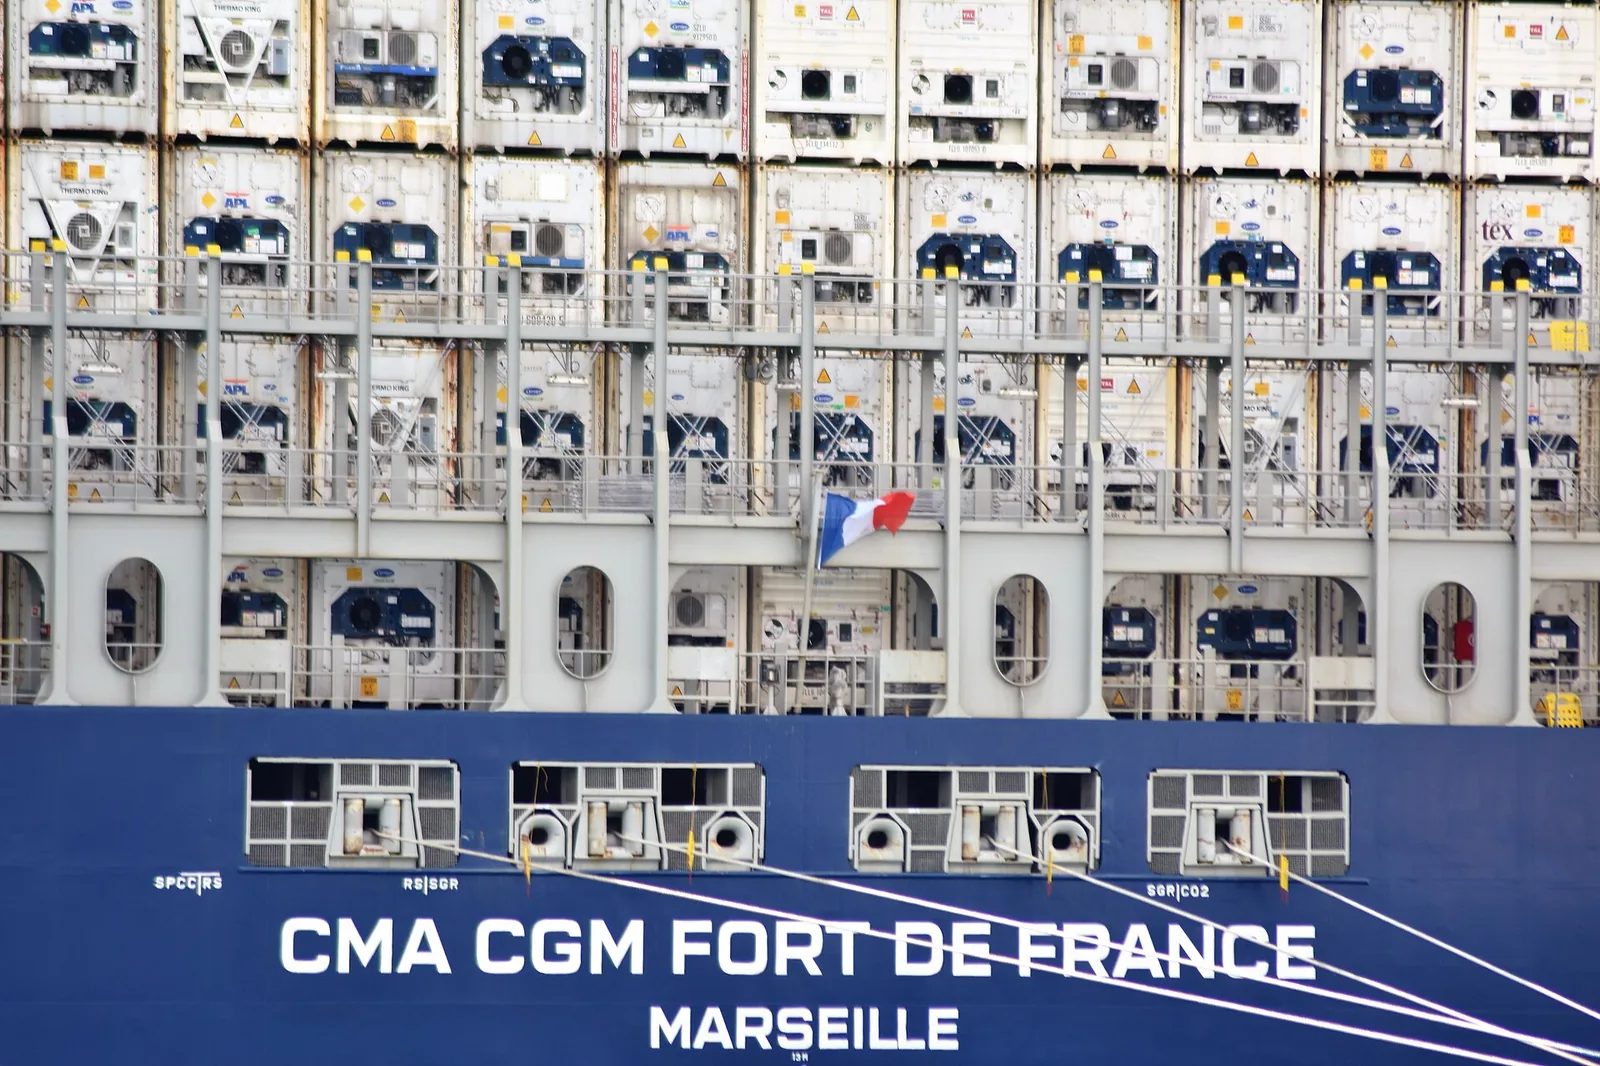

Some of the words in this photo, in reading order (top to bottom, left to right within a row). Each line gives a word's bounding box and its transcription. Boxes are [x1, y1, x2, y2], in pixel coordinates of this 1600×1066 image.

[72, 3, 97, 13] APL
[61, 187, 91, 195] THERMO
[91, 188, 108, 196] KING
[225, 198, 250, 208] APL
[1481, 220, 1513, 241] tex
[667, 231, 691, 241] APL
[224, 385, 249, 395] APL
[281, 917, 452, 974] CMA
[476, 918, 644, 975] CGM
[673, 920, 870, 976] FORT
[895, 921, 991, 977] DE
[1018, 922, 1316, 980] FRANCE
[650, 1006, 959, 1050] MARSEILLE
